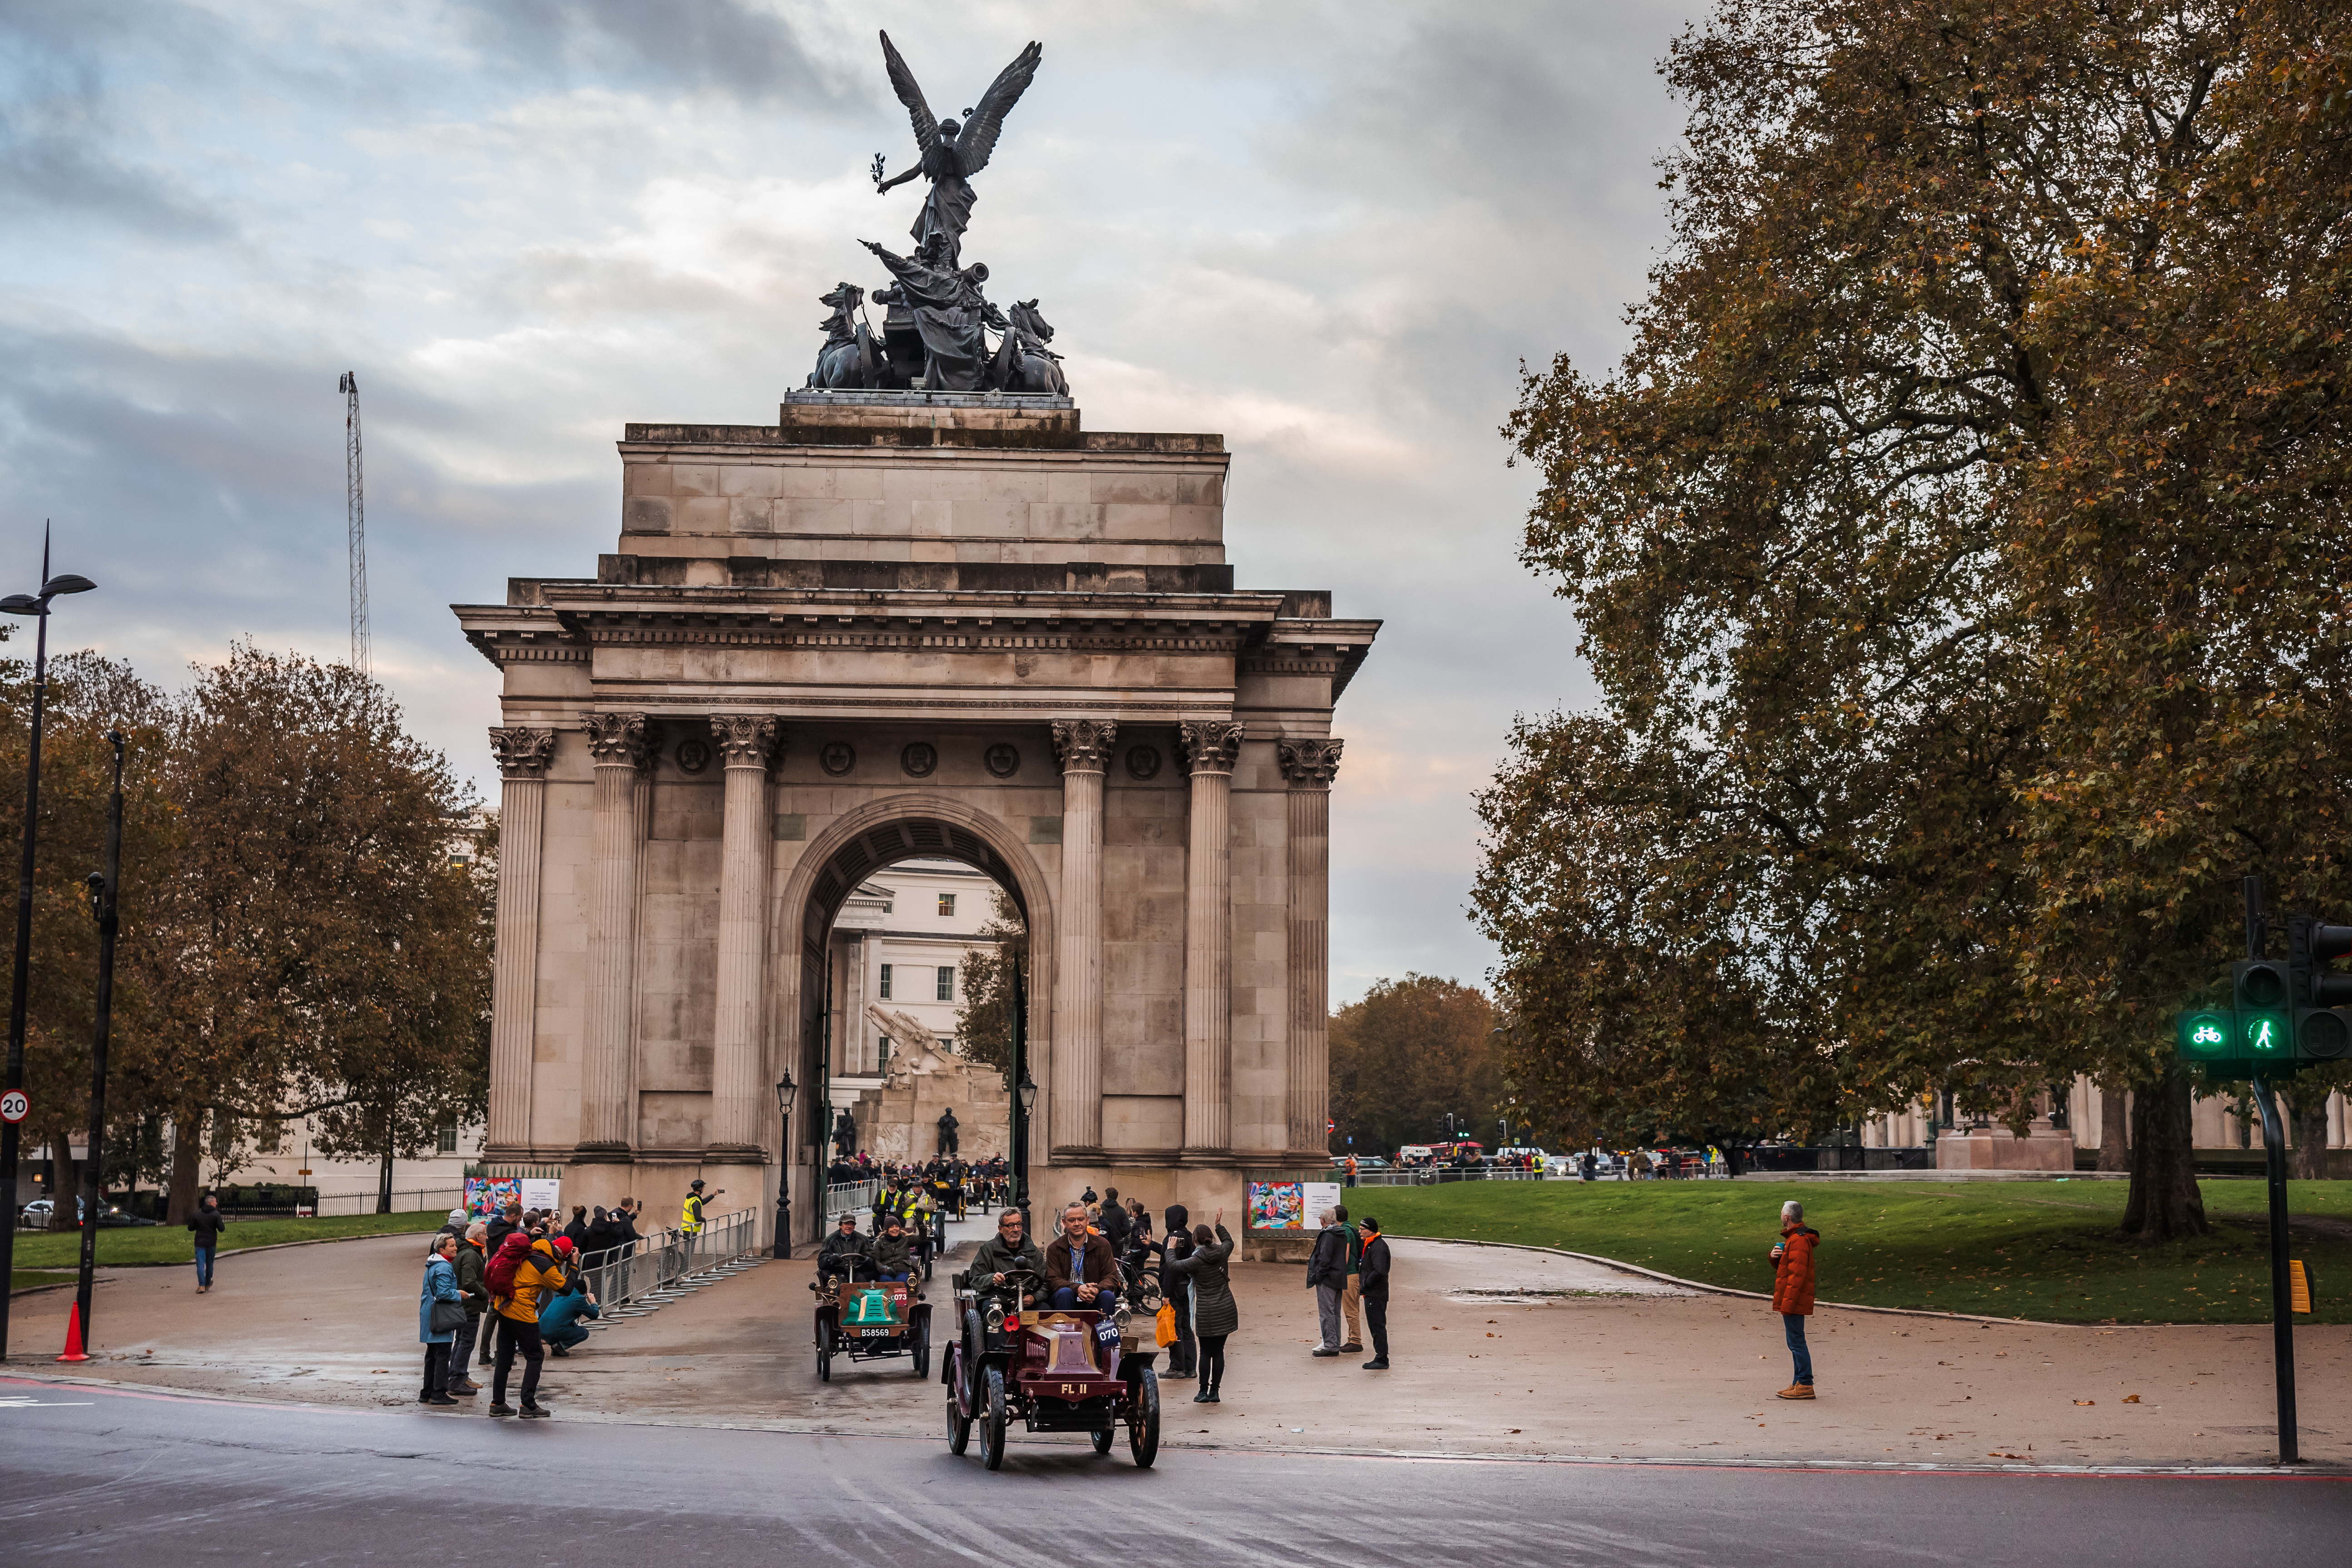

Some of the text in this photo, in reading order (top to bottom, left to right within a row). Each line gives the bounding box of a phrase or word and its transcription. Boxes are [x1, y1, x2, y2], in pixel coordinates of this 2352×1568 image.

[3, 1099, 25, 1113] 20
[1100, 1328, 1118, 1341] 070
[1061, 1384, 1075, 1394] FL
